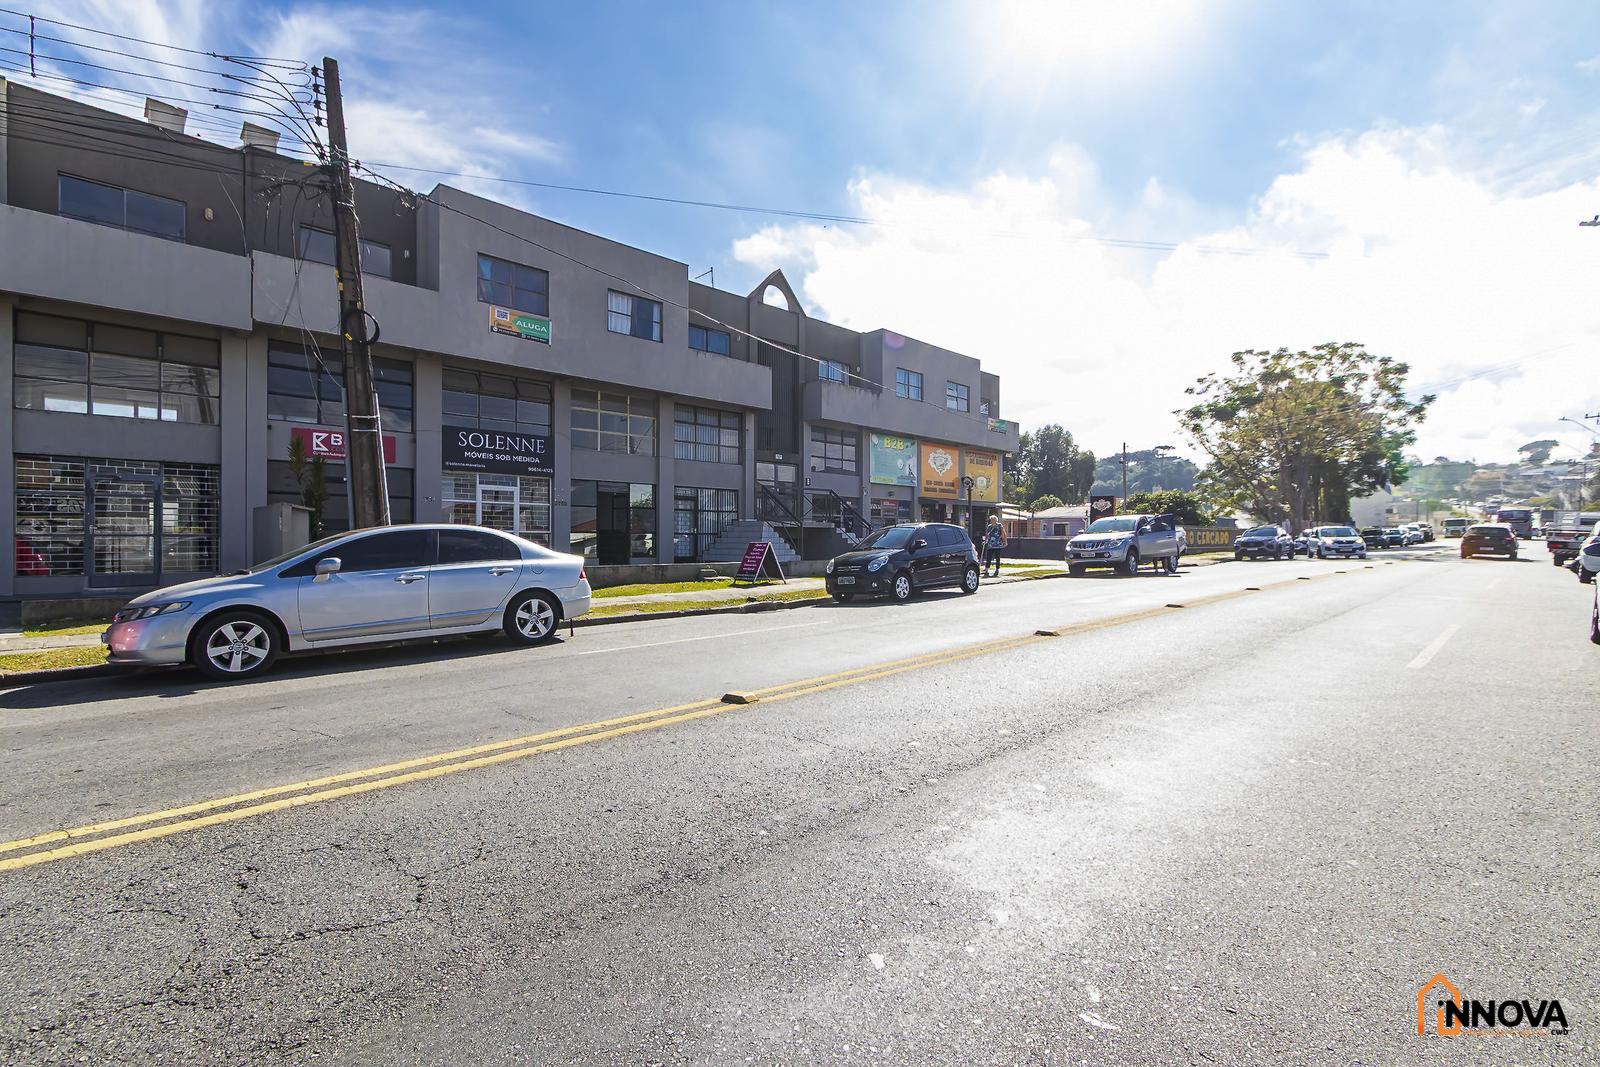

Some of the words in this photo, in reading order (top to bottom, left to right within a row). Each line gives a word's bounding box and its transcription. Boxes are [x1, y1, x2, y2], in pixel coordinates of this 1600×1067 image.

[516, 320, 548, 333] ALUGA
[458, 431, 546, 454] SOLENNE
[884, 436, 905, 450] B2B
[464, 450, 494, 460] MÓVEIS
[495, 453, 511, 462] SOB
[512, 455, 540, 464] MEDIDA
[1196, 530, 1230, 545] CERCADO
